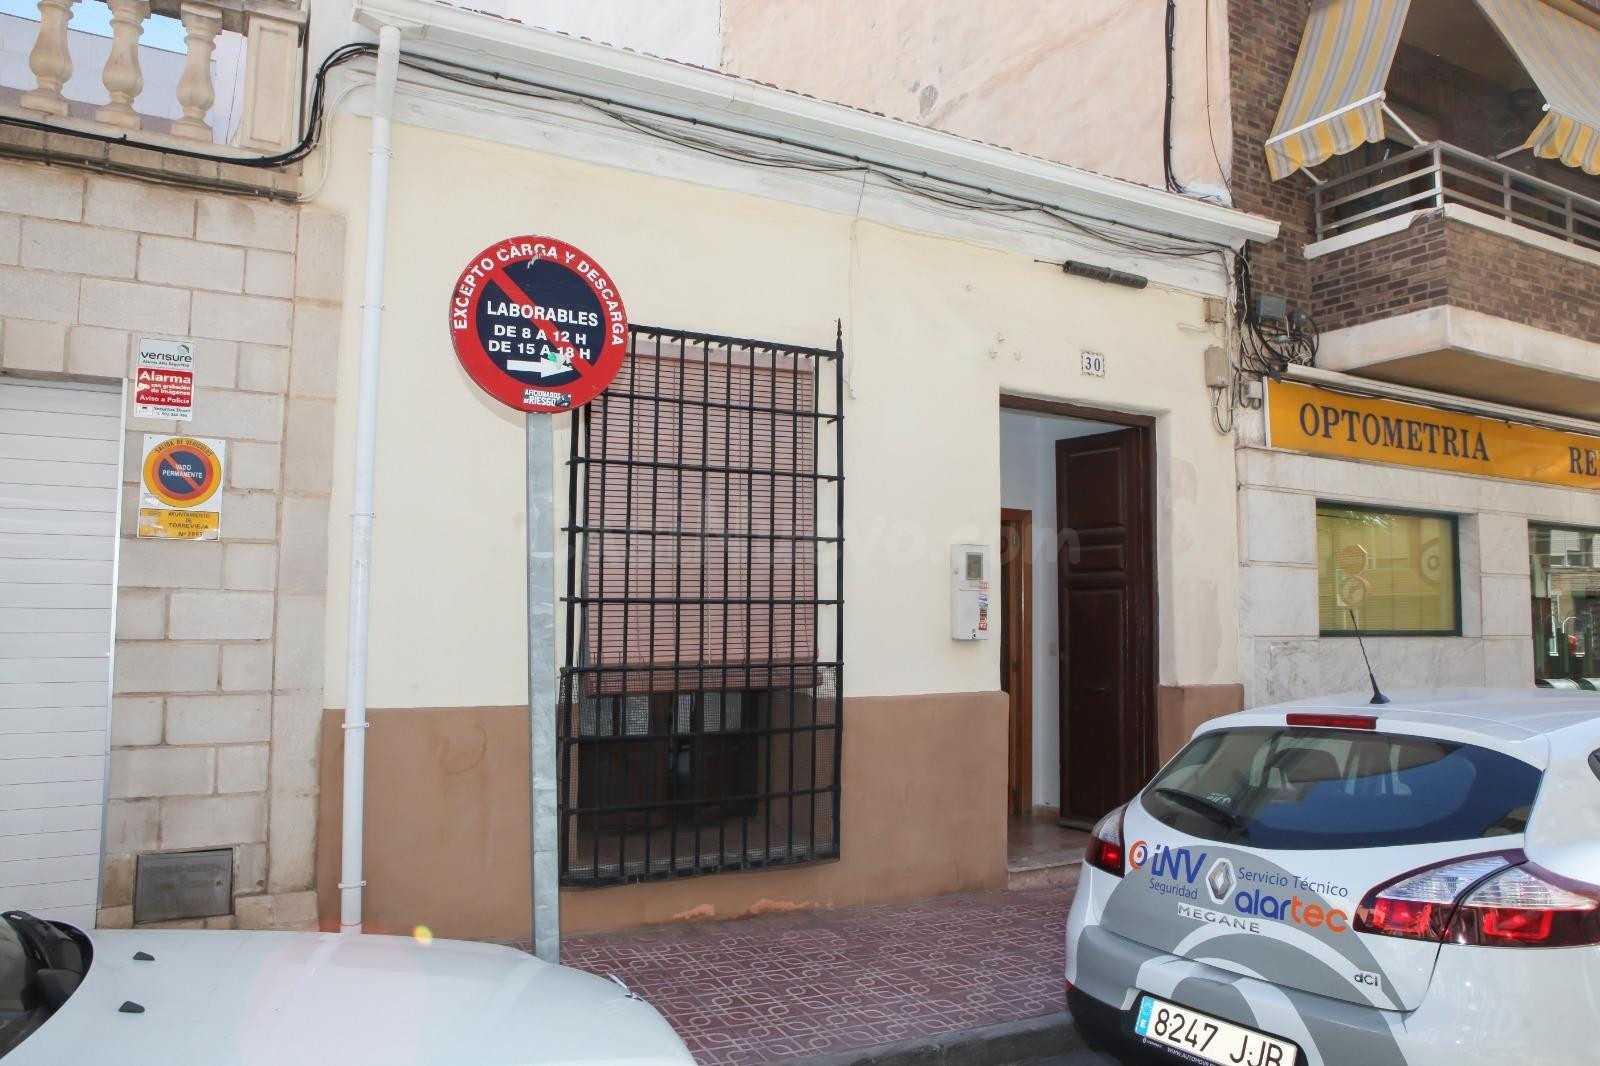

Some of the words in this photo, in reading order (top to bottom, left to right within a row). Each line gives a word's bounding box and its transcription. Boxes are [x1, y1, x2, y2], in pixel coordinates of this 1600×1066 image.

[454, 257, 494, 330] EXCEPTO
[496, 243, 558, 262] CARGA
[565, 251, 576, 264] Y
[577, 260, 625, 346] DESCARGA
[487, 301, 599, 327] LABORABLES
[494, 324, 517, 338] DE
[521, 328, 532, 339] 8
[536, 329, 548, 341] A
[553, 331, 570, 343] 12
[575, 333, 587, 345] H
[141, 351, 192, 363] verisure
[488, 340, 511, 353] DE
[517, 342, 535, 355] 15
[540, 344, 551, 357] A
[557, 346, 575, 358] 18
[579, 348, 591, 360] H
[1085, 356, 1101, 372] 30
[139, 370, 191, 384] Alarma
[140, 394, 159, 402] Aviso
[529, 395, 557, 407] RIESGO
[1300, 402, 1490, 462] OPTOMETRIA
[162, 469, 203, 479] PERMANENTE
[175, 463, 192, 471] VADO
[1149, 877, 1198, 900] Seguridad
[1238, 866, 1288, 887] Servicio
[1292, 875, 1348, 898] Técnico
[1178, 904, 1261, 934] MEGANE
[1235, 889, 1348, 933] alartec
[1139, 1018, 1147, 1029] E
[1154, 1008, 1219, 1052] 8247
